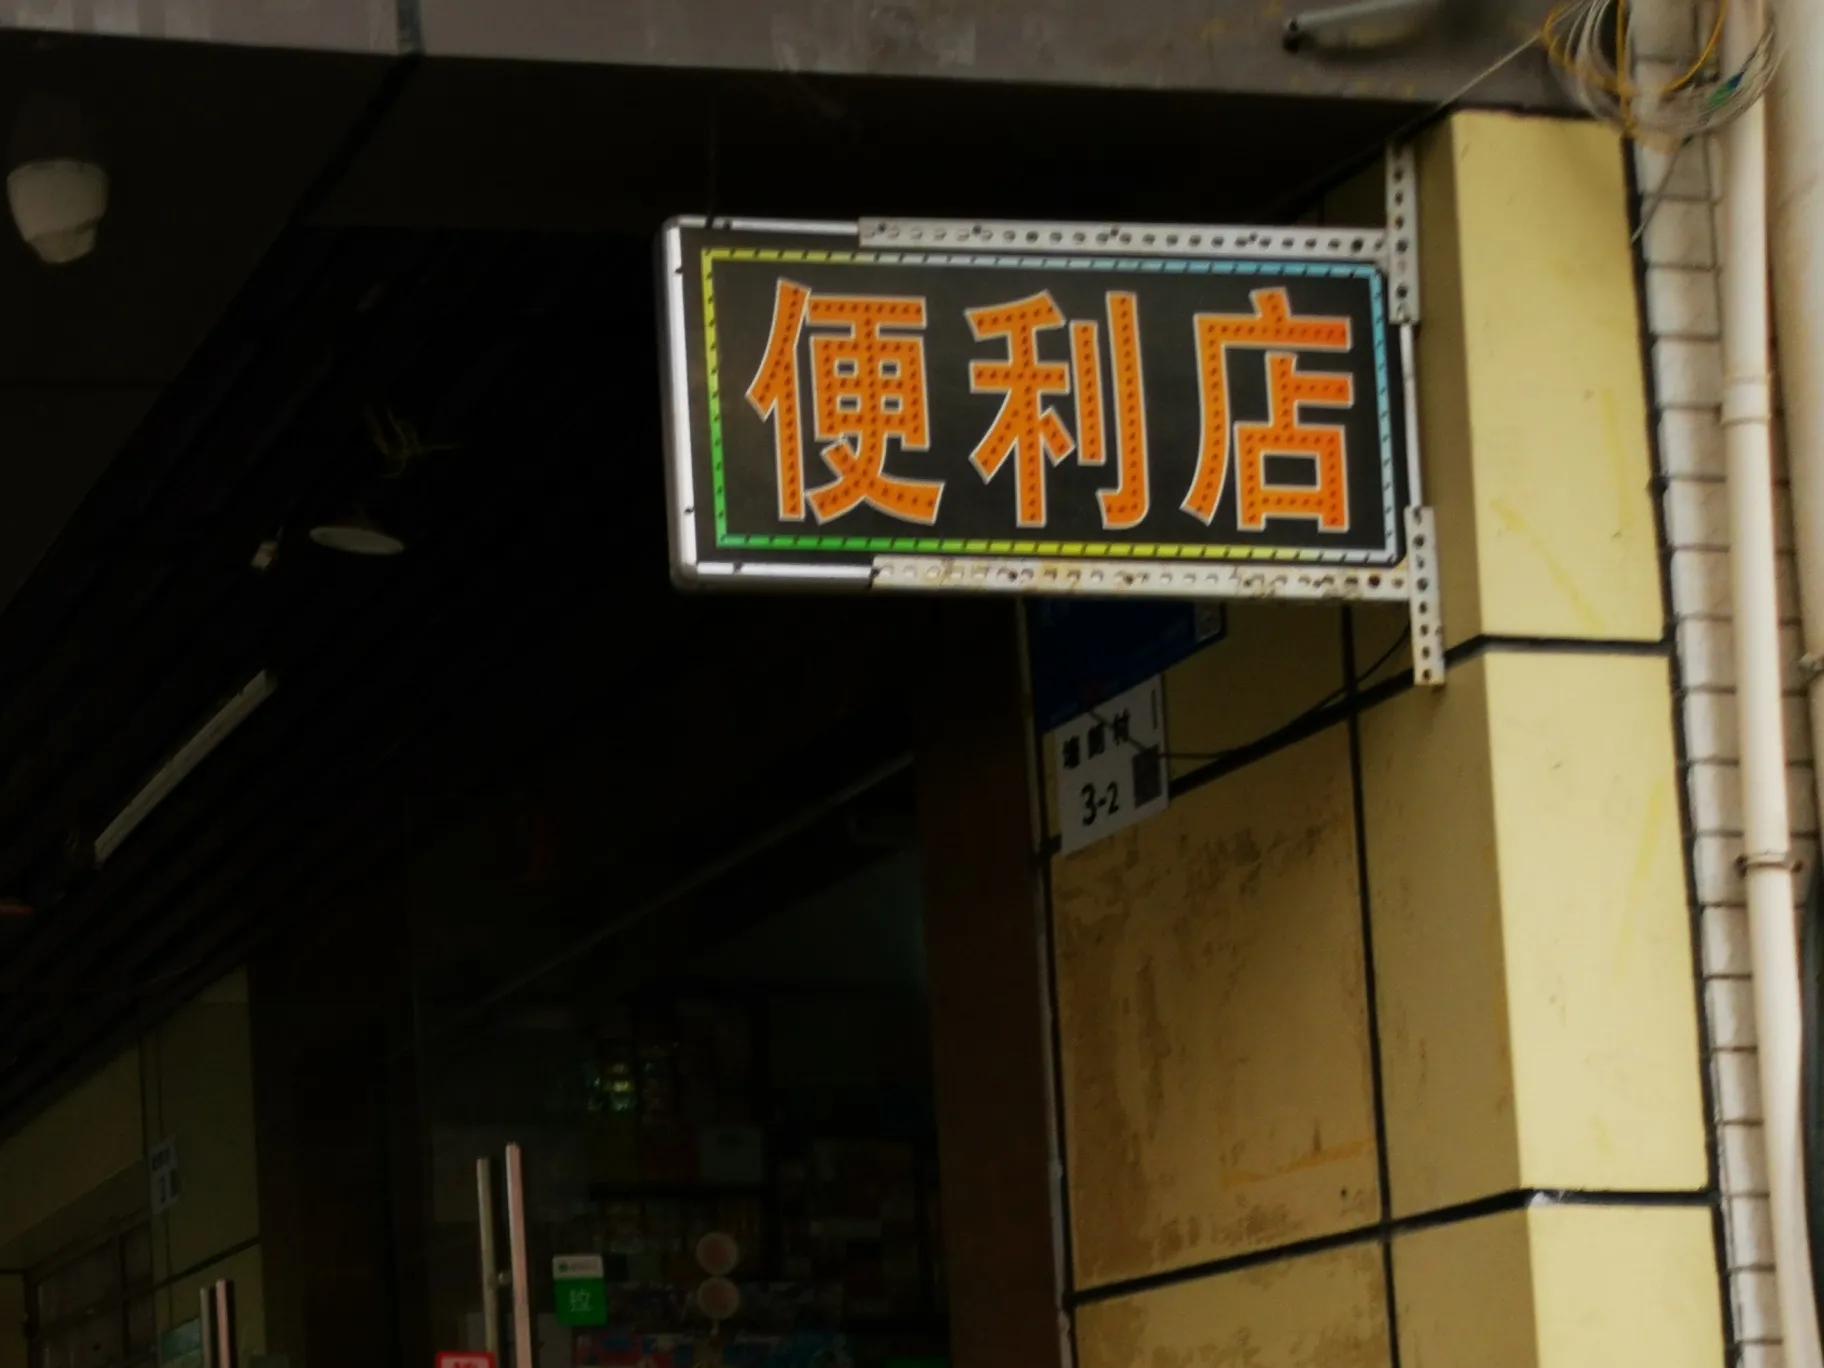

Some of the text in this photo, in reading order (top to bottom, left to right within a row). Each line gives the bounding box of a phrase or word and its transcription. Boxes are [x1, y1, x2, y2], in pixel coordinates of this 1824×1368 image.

[746, 277, 1355, 534] 便利店
[1080, 781, 1119, 826] 3-2
